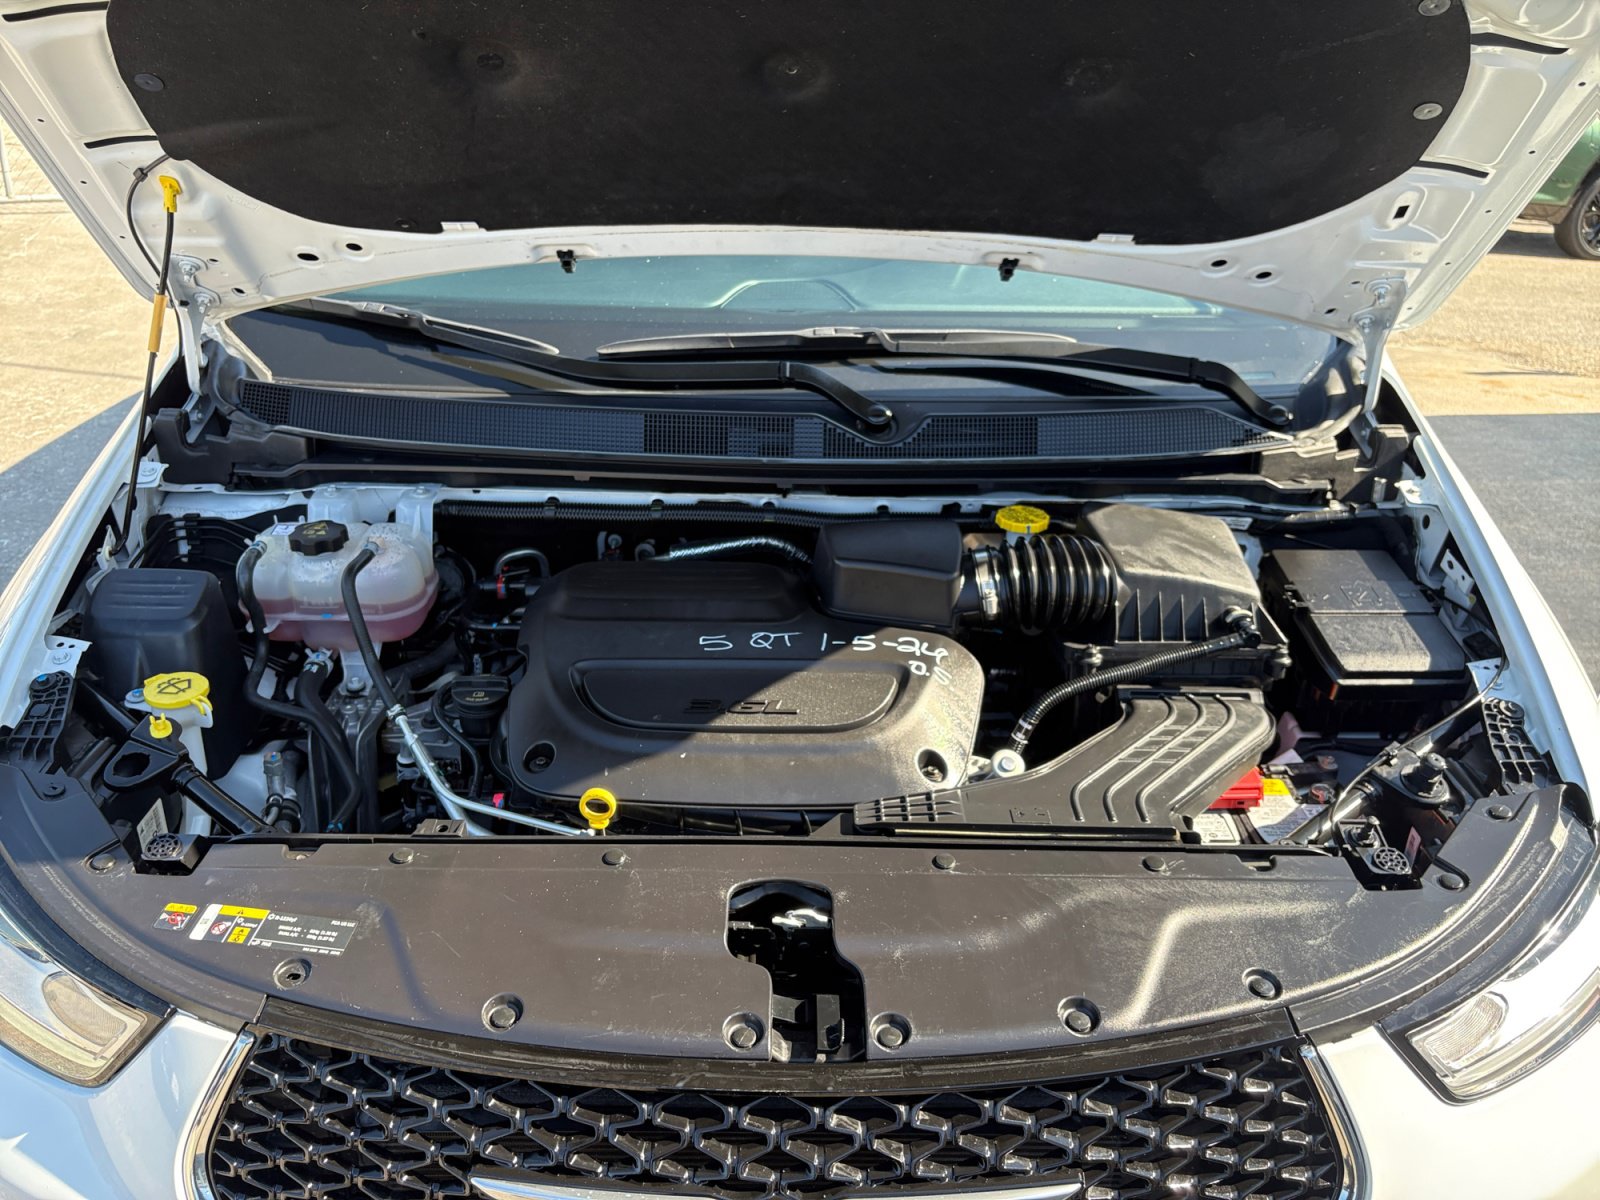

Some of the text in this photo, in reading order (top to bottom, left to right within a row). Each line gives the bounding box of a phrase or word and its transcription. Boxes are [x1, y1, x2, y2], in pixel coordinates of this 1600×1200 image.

[699, 634, 733, 651] 5
[750, 632, 803, 649] QT
[684, 699, 800, 715] 3.6L
